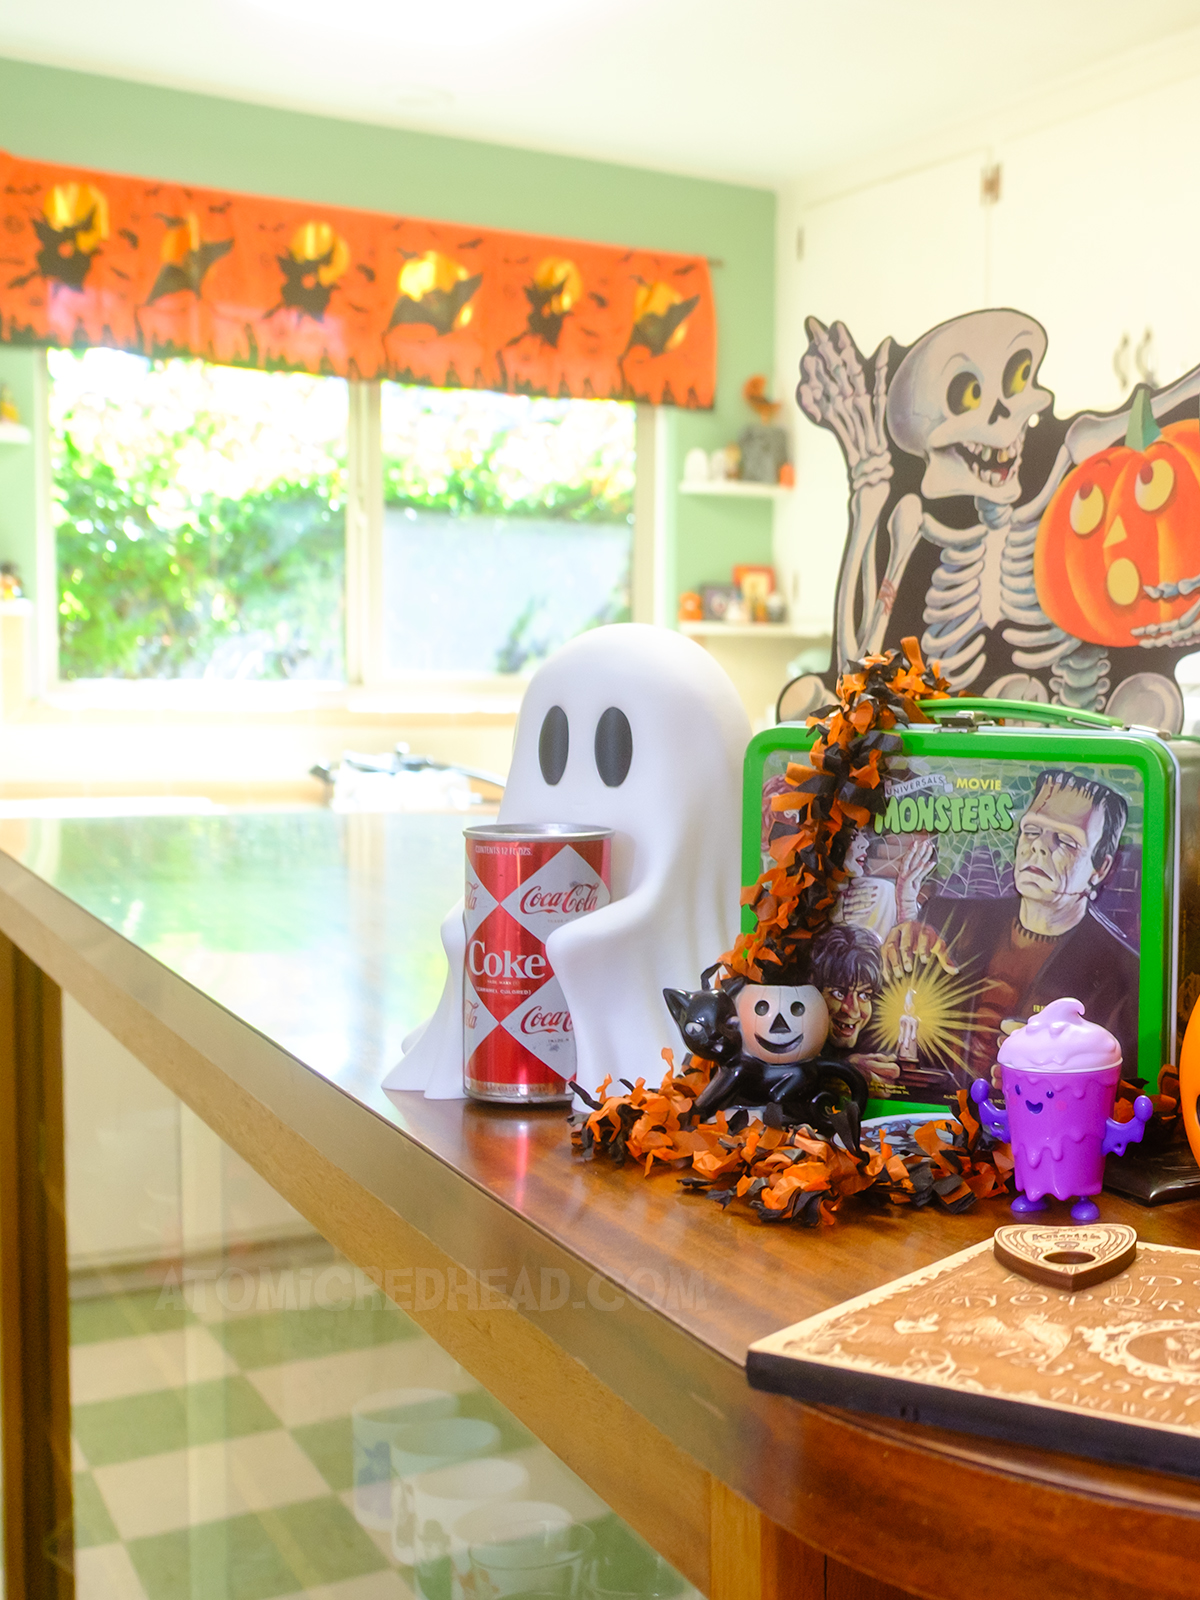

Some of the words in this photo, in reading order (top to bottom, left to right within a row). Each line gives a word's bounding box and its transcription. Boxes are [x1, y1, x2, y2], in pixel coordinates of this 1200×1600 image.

[956, 777, 1001, 791] MOVIE
[874, 793, 1013, 834] MONSTERS
[519, 882, 600, 914] Coca-Cola
[468, 940, 546, 979] Coke
